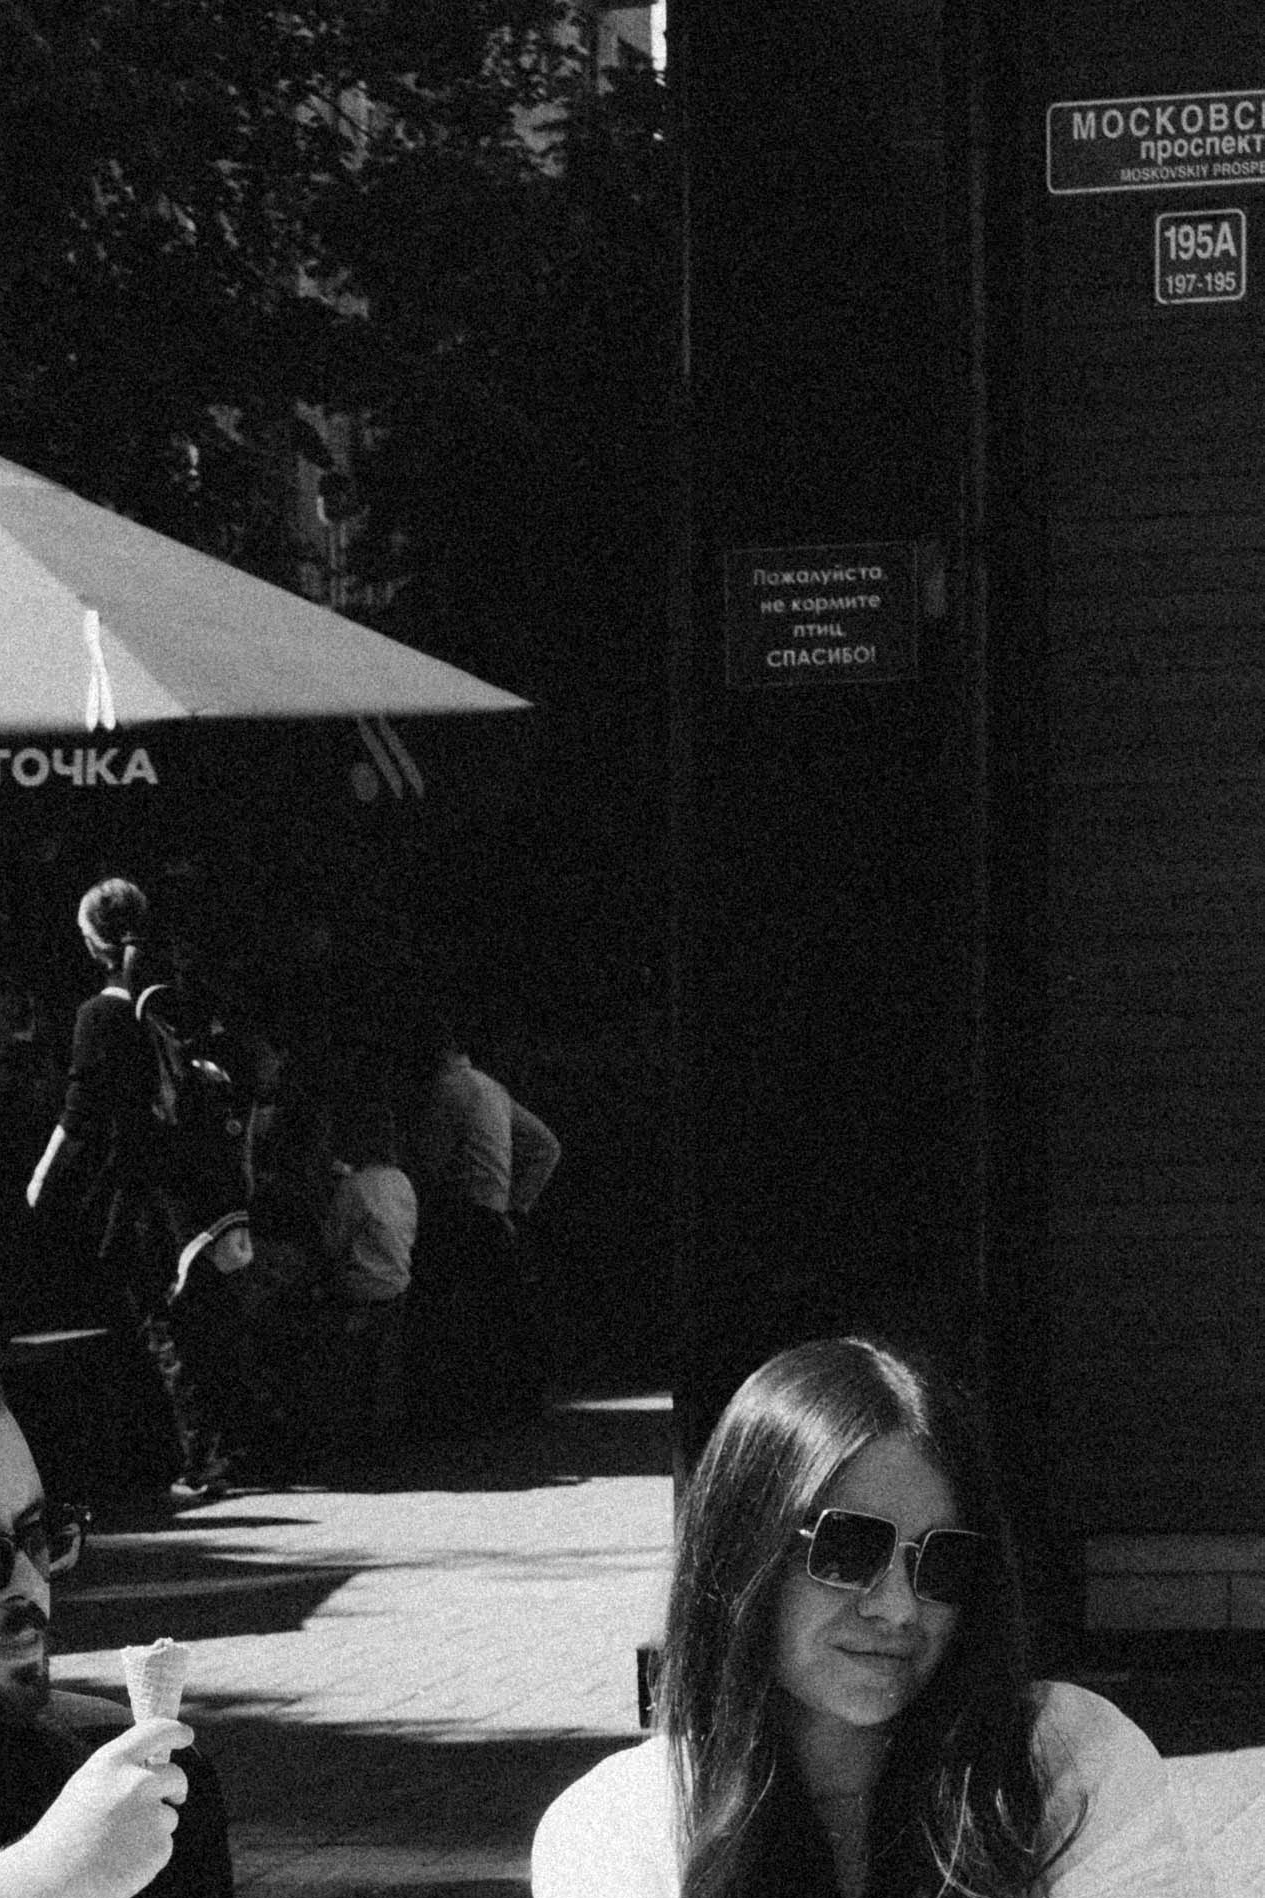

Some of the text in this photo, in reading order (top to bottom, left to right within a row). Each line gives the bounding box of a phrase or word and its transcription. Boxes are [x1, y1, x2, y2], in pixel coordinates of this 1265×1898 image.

[1140, 134, 1265, 165] проспект
[1164, 221, 1236, 261] 195А
[1165, 271, 1236, 294] 197-195
[760, 594, 881, 615] не кормите
[766, 644, 877, 668] СПАСИБО!
